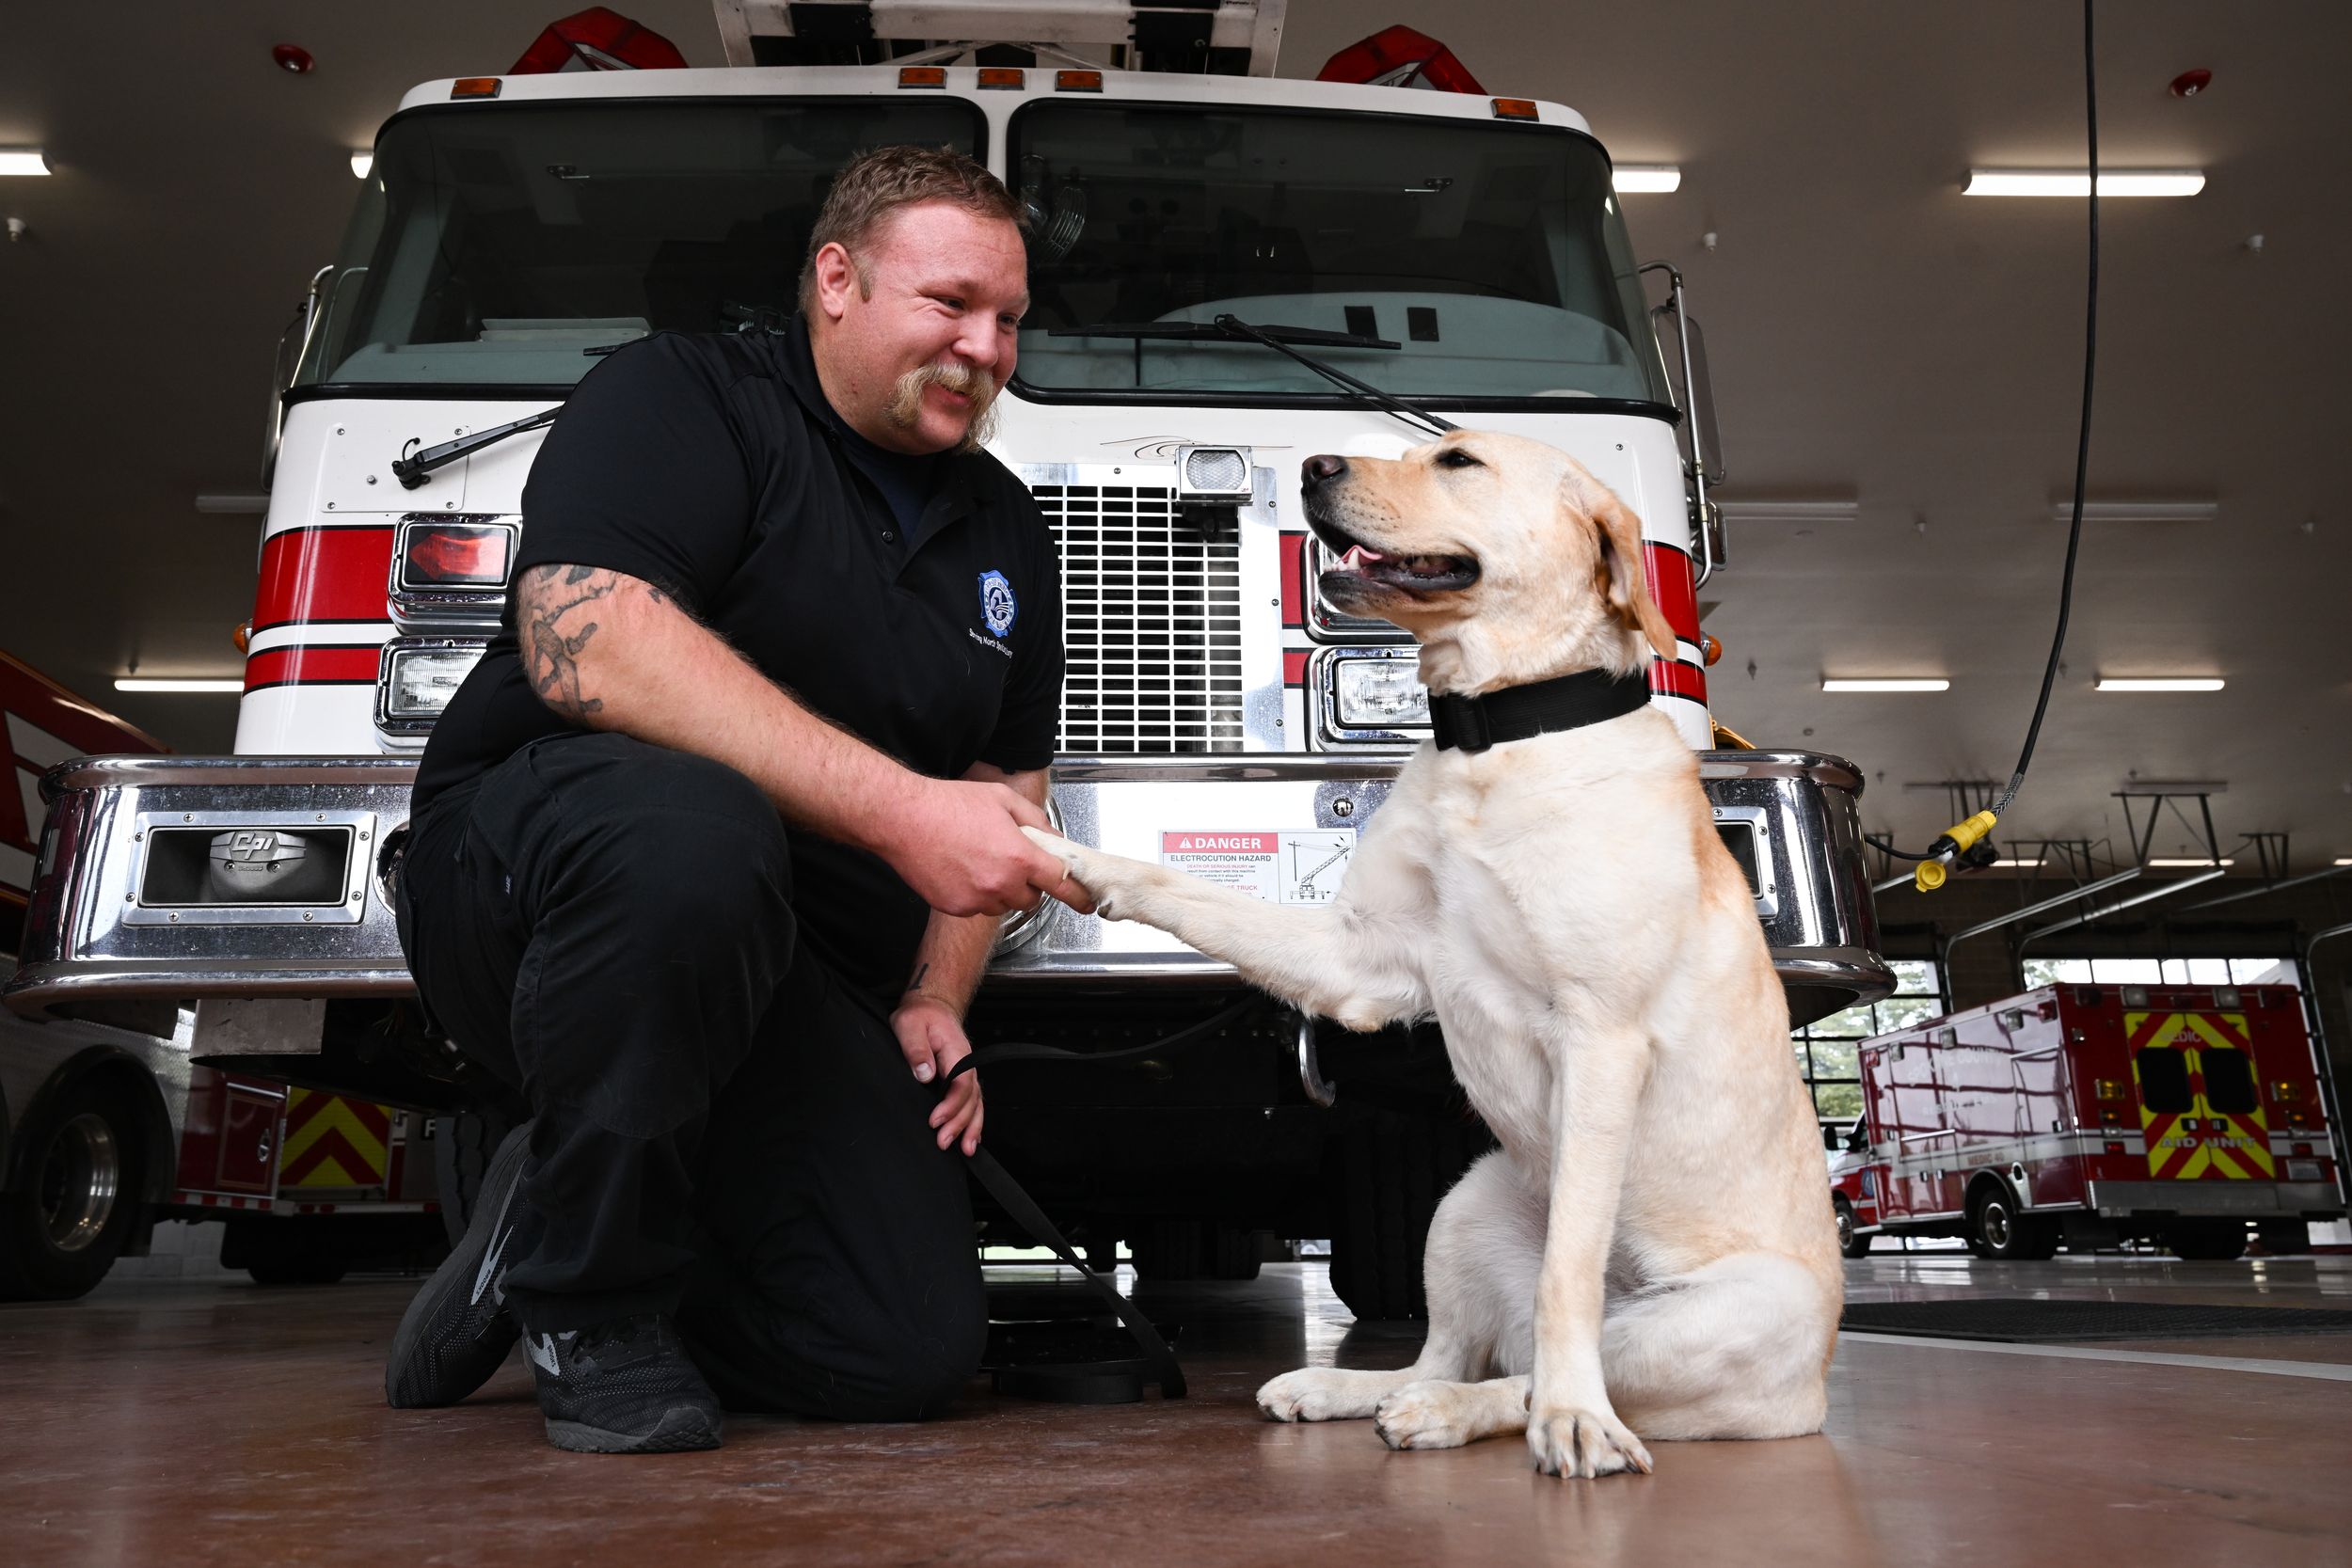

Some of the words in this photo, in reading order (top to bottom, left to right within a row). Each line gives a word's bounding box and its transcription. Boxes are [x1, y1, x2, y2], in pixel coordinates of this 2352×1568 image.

[1195, 837, 1262, 849] DANGER
[2161, 1136, 2198, 1148] AID
[2204, 1136, 2256, 1148] UNIT
[475, 1268, 491, 1296] BROOKS
[547, 1344, 557, 1368] BROOKS
